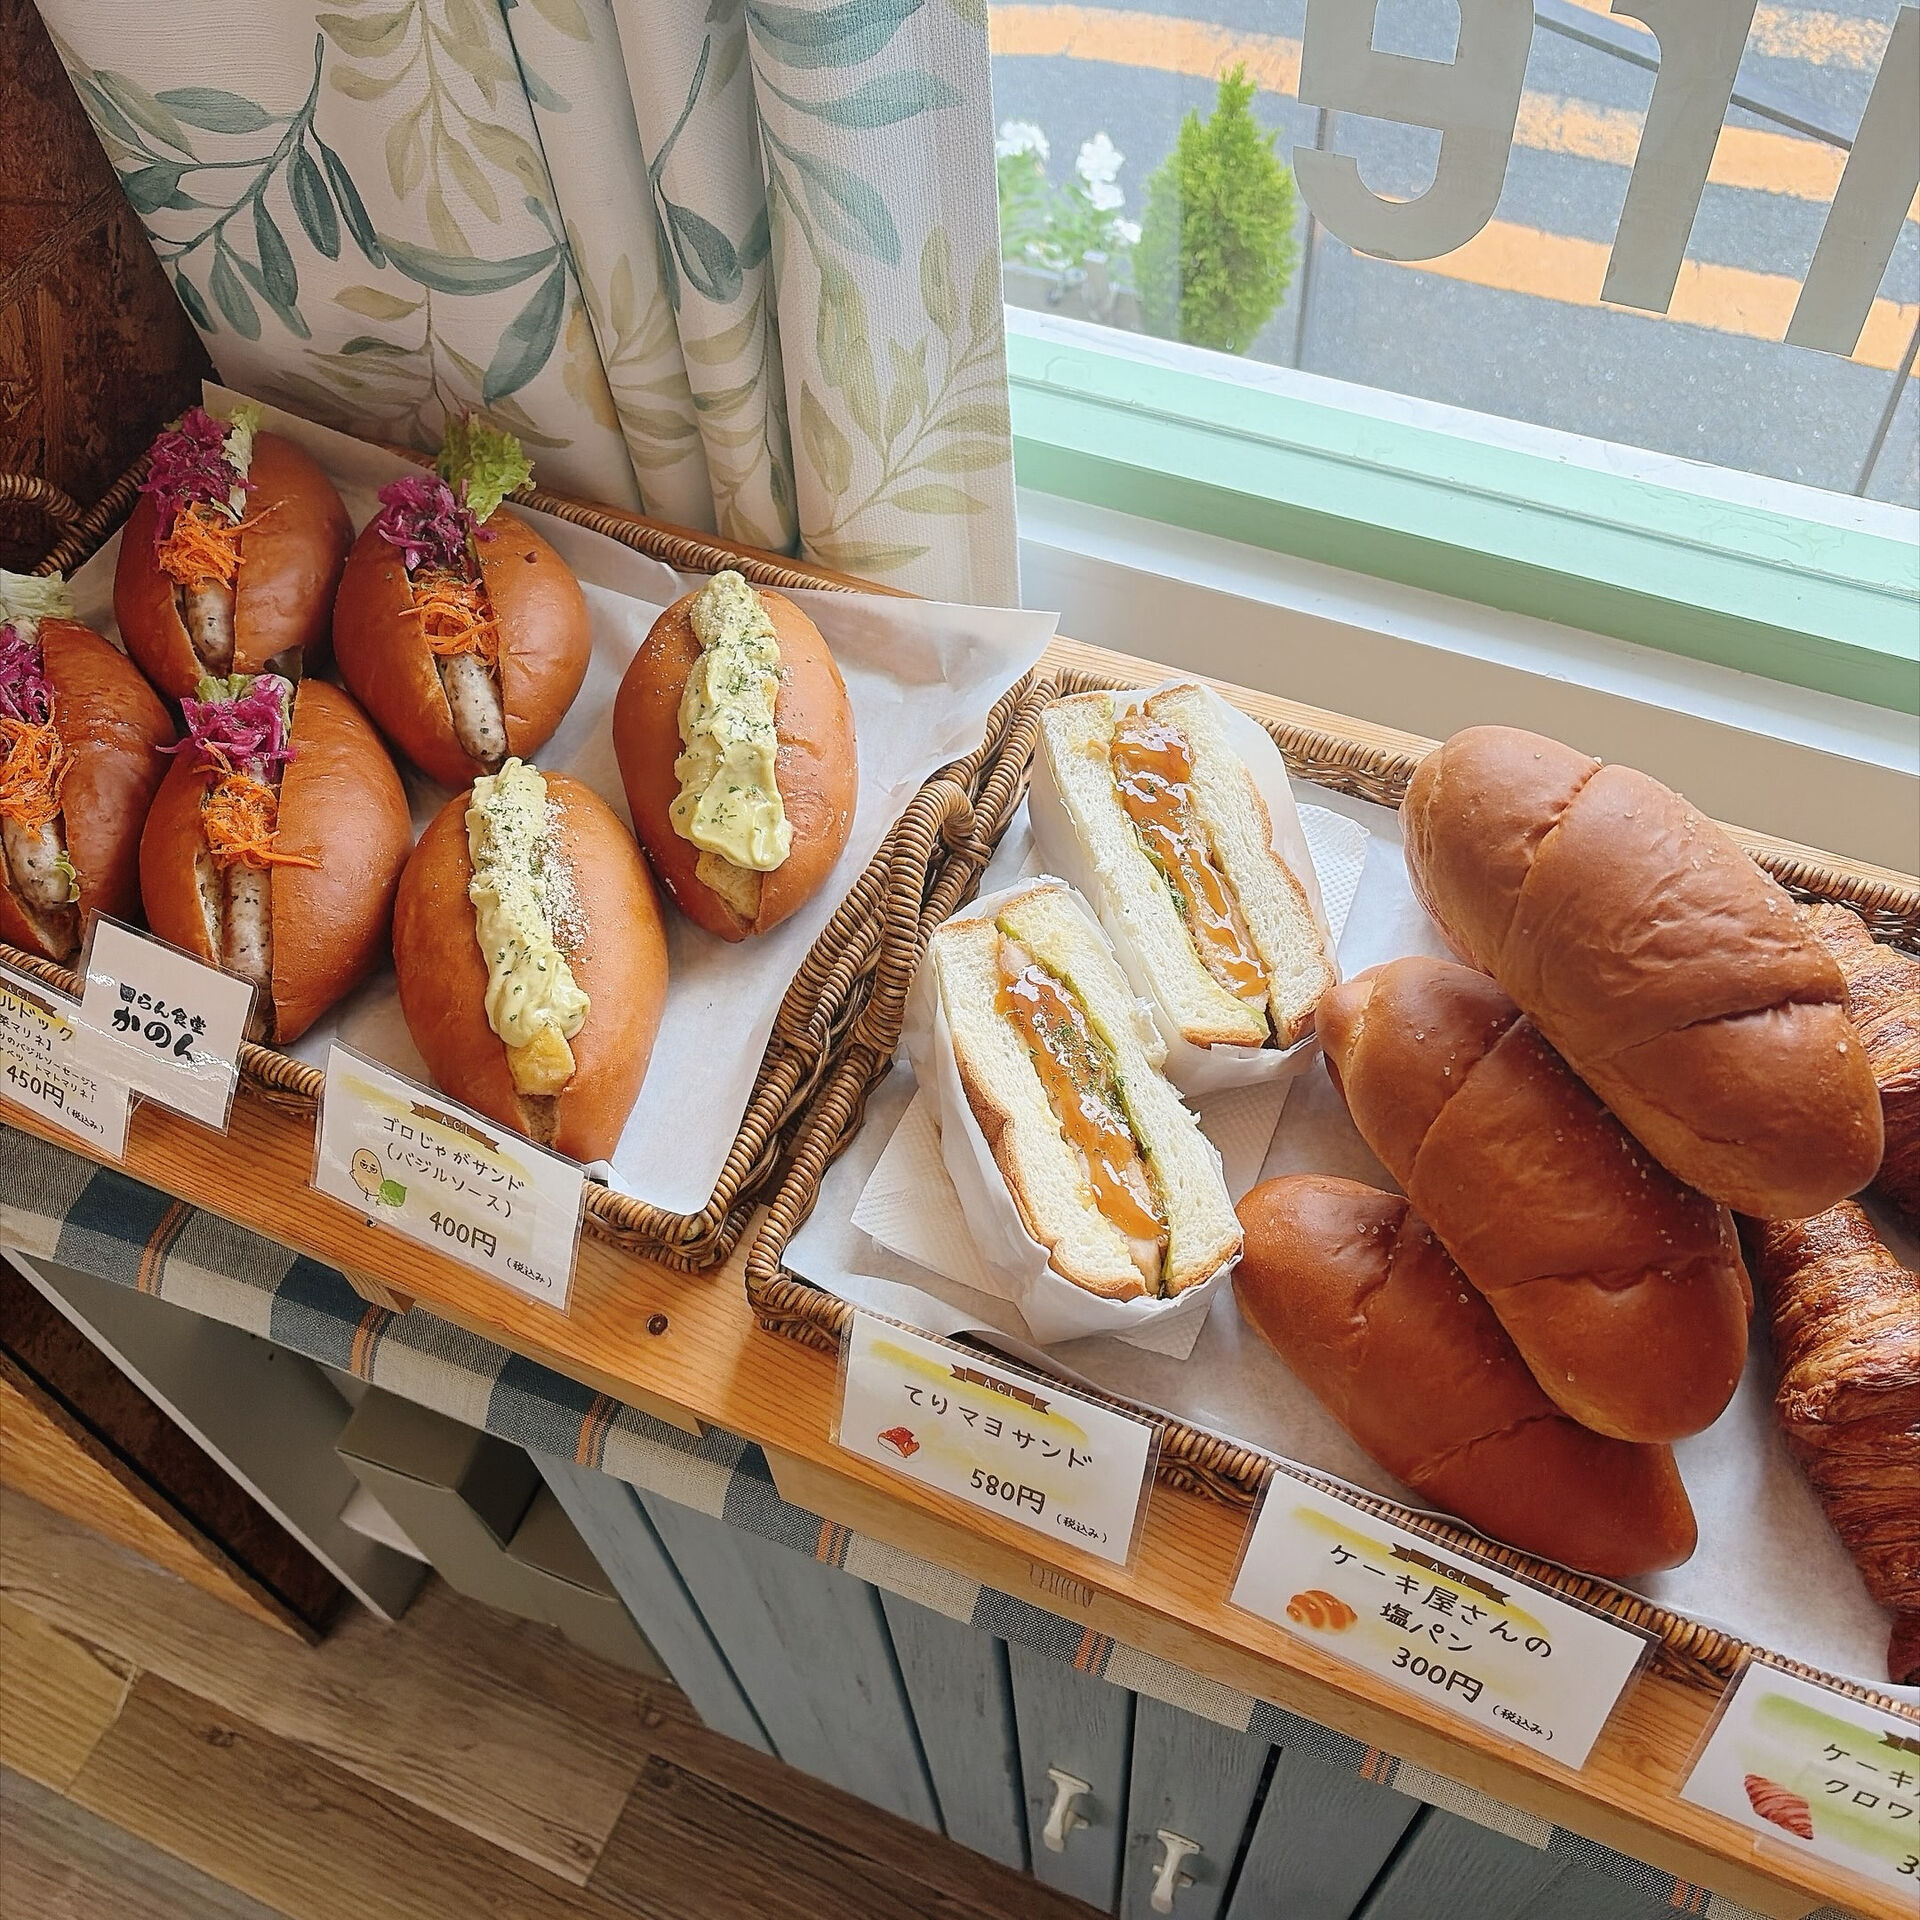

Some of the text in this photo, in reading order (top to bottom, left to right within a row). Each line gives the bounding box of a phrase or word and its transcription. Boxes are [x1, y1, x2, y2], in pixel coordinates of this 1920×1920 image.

[112, 1006, 194, 1063] かのん
[6, 1065, 64, 1109] 450円
[383, 1116, 525, 1191] ゴロじゃがサンド
[429, 1211, 497, 1258] 400円
[904, 1384, 1093, 1468] てりマヨサンド
[970, 1468, 1046, 1515] 580円
[1329, 1544, 1553, 1659] ケーキ屋さんの
[1379, 1602, 1473, 1654] 塩パン
[1391, 1646, 1484, 1704] 300円
[1896, 1854, 1920, 1882] 3
